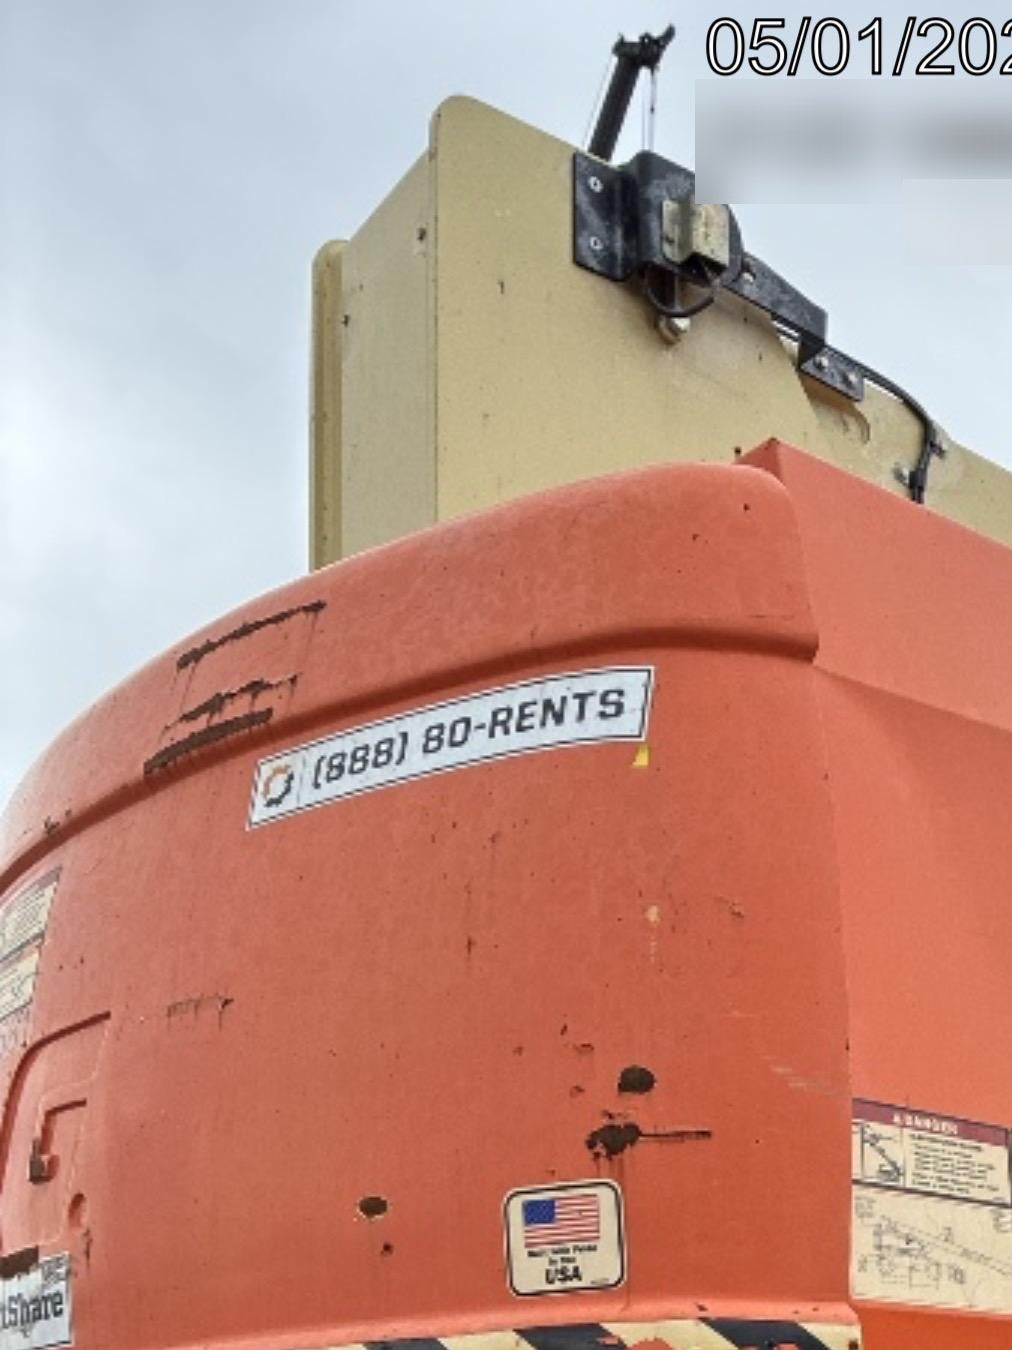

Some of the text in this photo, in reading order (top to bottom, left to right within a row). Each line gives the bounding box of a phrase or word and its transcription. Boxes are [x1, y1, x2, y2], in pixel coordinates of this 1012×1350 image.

[311, 688, 626, 789] (888) 80-RENTS
[544, 1264, 583, 1285] USA
